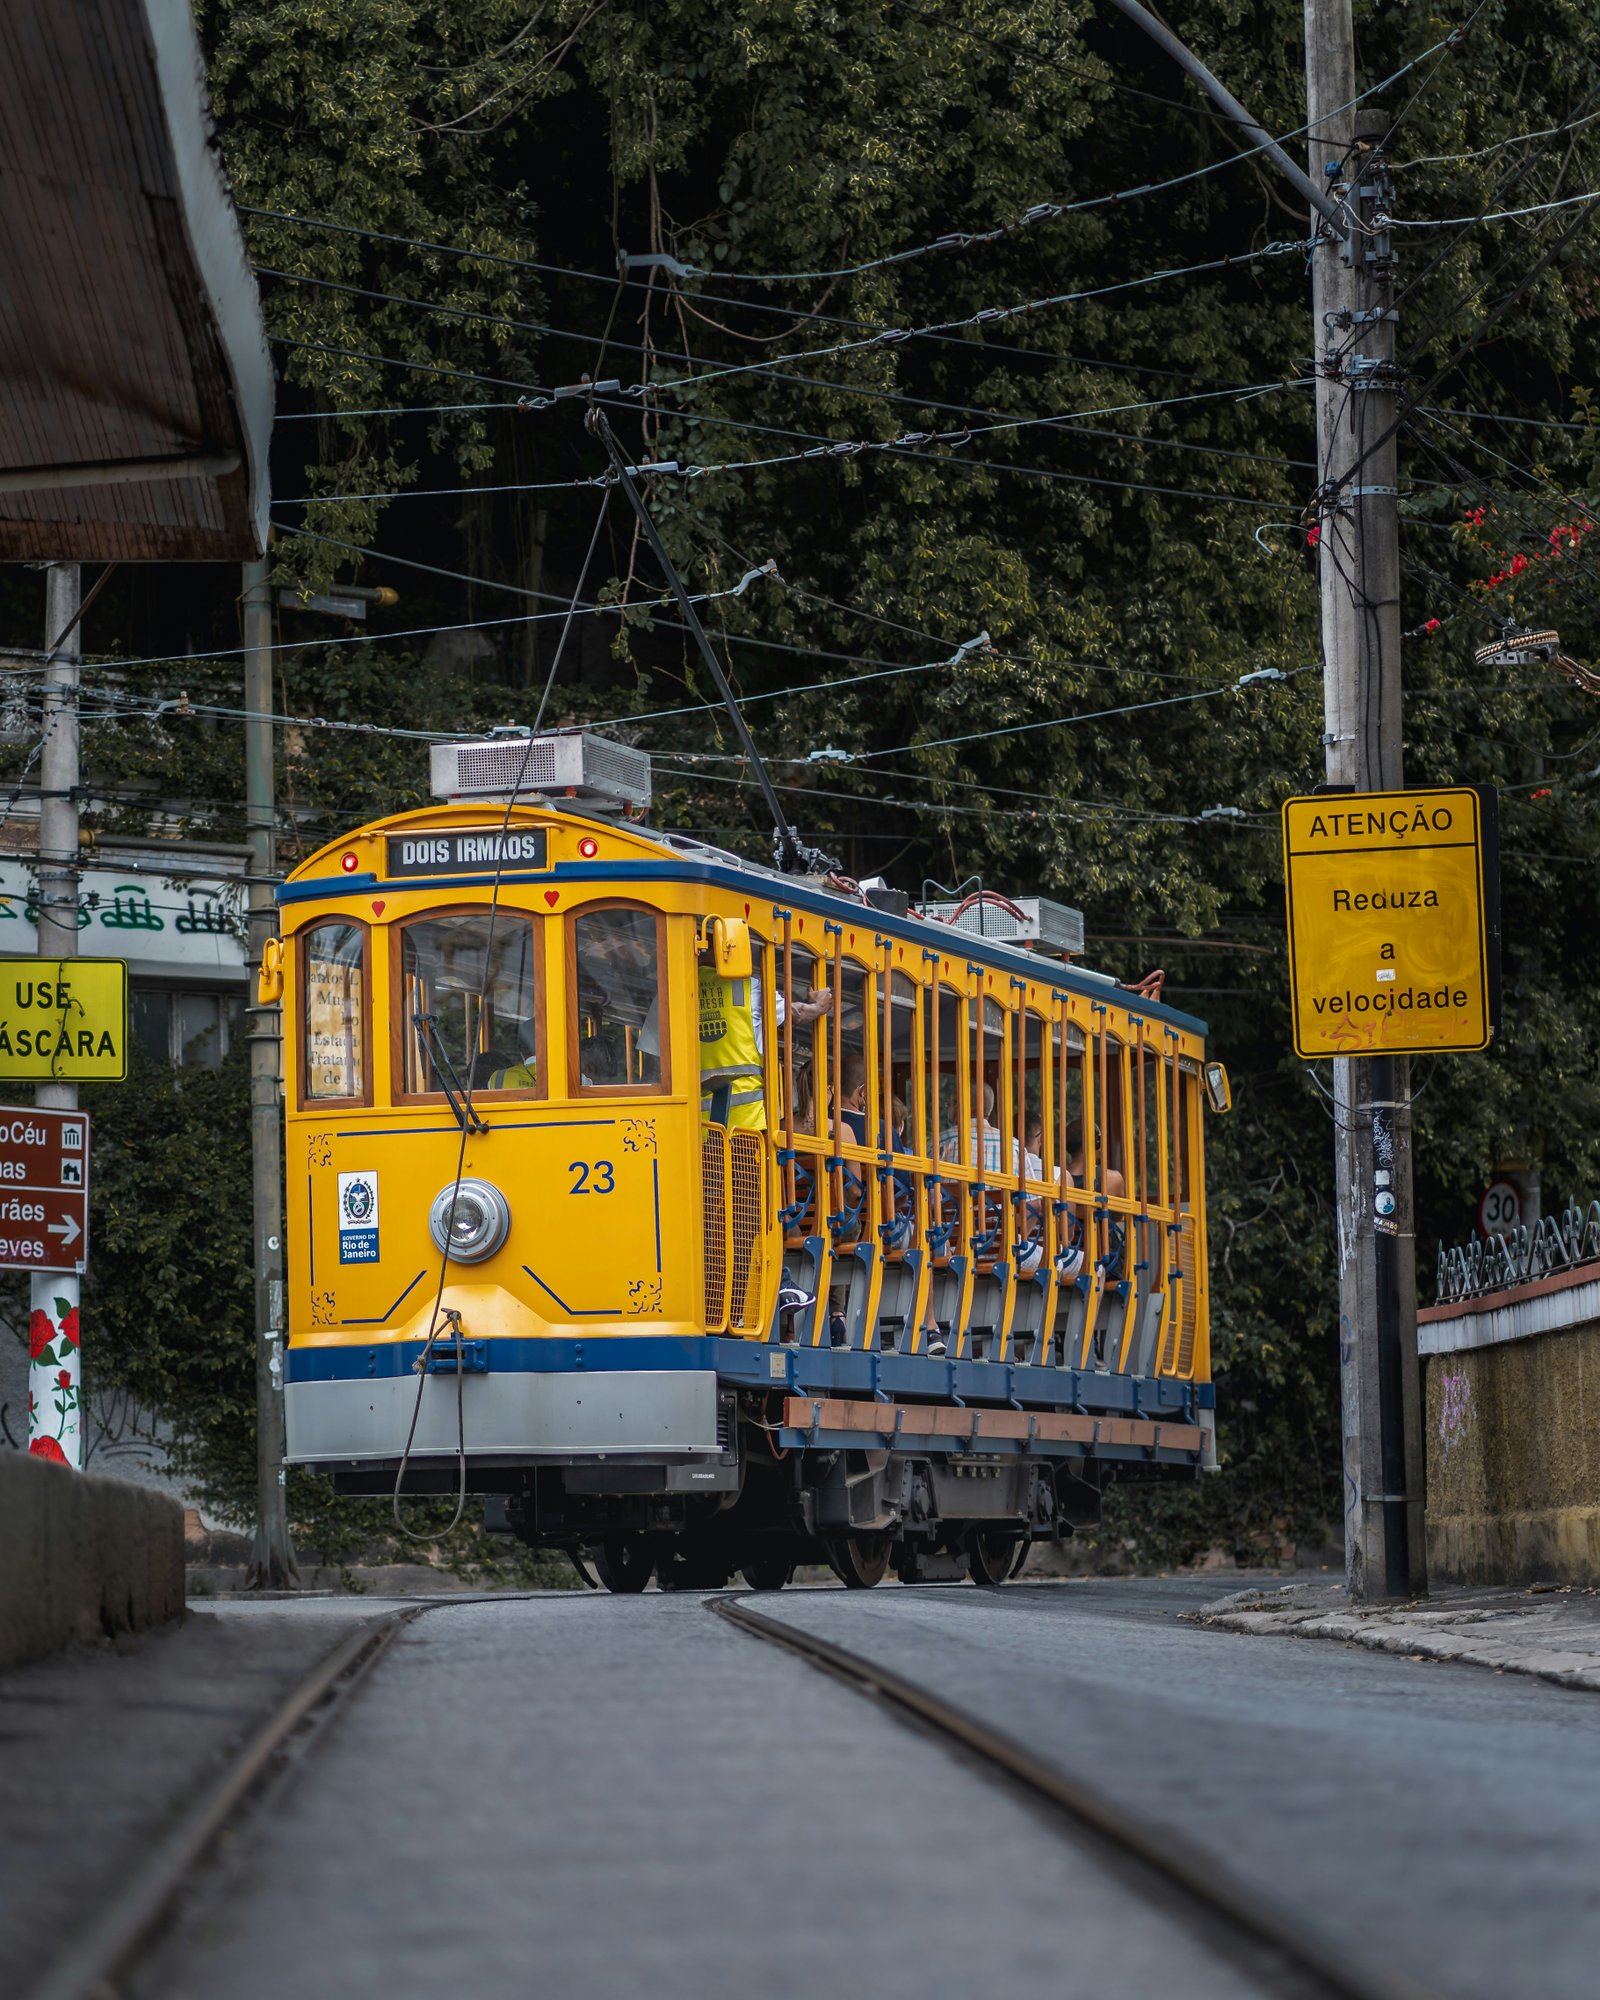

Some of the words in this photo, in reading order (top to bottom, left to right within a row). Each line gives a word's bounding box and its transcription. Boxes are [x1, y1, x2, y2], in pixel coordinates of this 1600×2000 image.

[1309, 803, 1453, 839] ATENÇÃO
[402, 839, 450, 865] DOIS
[1333, 888, 1439, 911] Reduza
[1380, 943, 1396, 960] a
[15, 981, 72, 1010] USE
[1312, 985, 1468, 1014] velocidade
[323, 1070, 341, 1085] de
[10, 1120, 47, 1146] Céu
[568, 1160, 615, 1194] 23
[1487, 1193, 1515, 1223] 30
[342, 1240, 356, 1249] Rio
[358, 1240, 369, 1248] de
[343, 1249, 376, 1258] Janeiro
